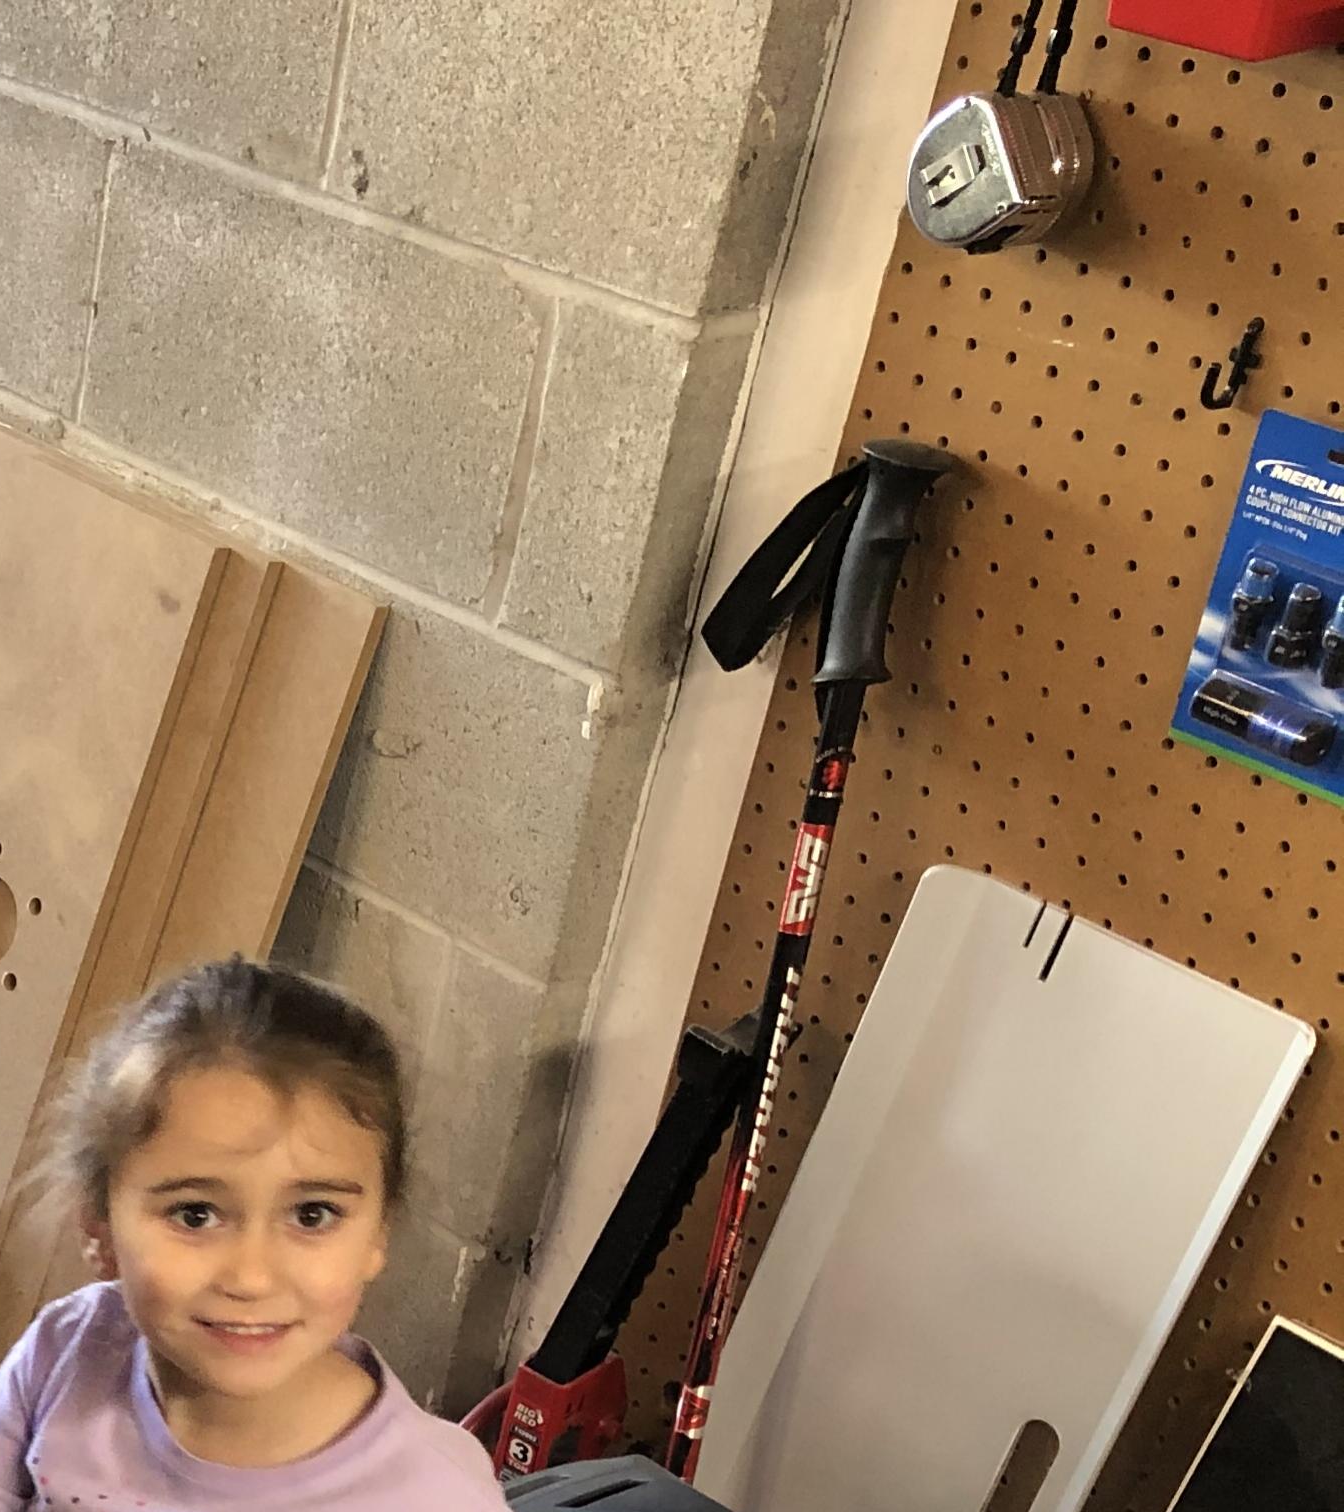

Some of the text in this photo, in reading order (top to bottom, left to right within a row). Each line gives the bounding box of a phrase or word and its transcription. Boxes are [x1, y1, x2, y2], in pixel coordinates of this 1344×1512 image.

[1245, 494, 1344, 537] COUPLER CONNECTOR KIT
[1269, 491, 1288, 506] HIGH
[1288, 496, 1312, 514] FLOW
[784, 831, 830, 925] EMS
[512, 1441, 529, 1463] 3
